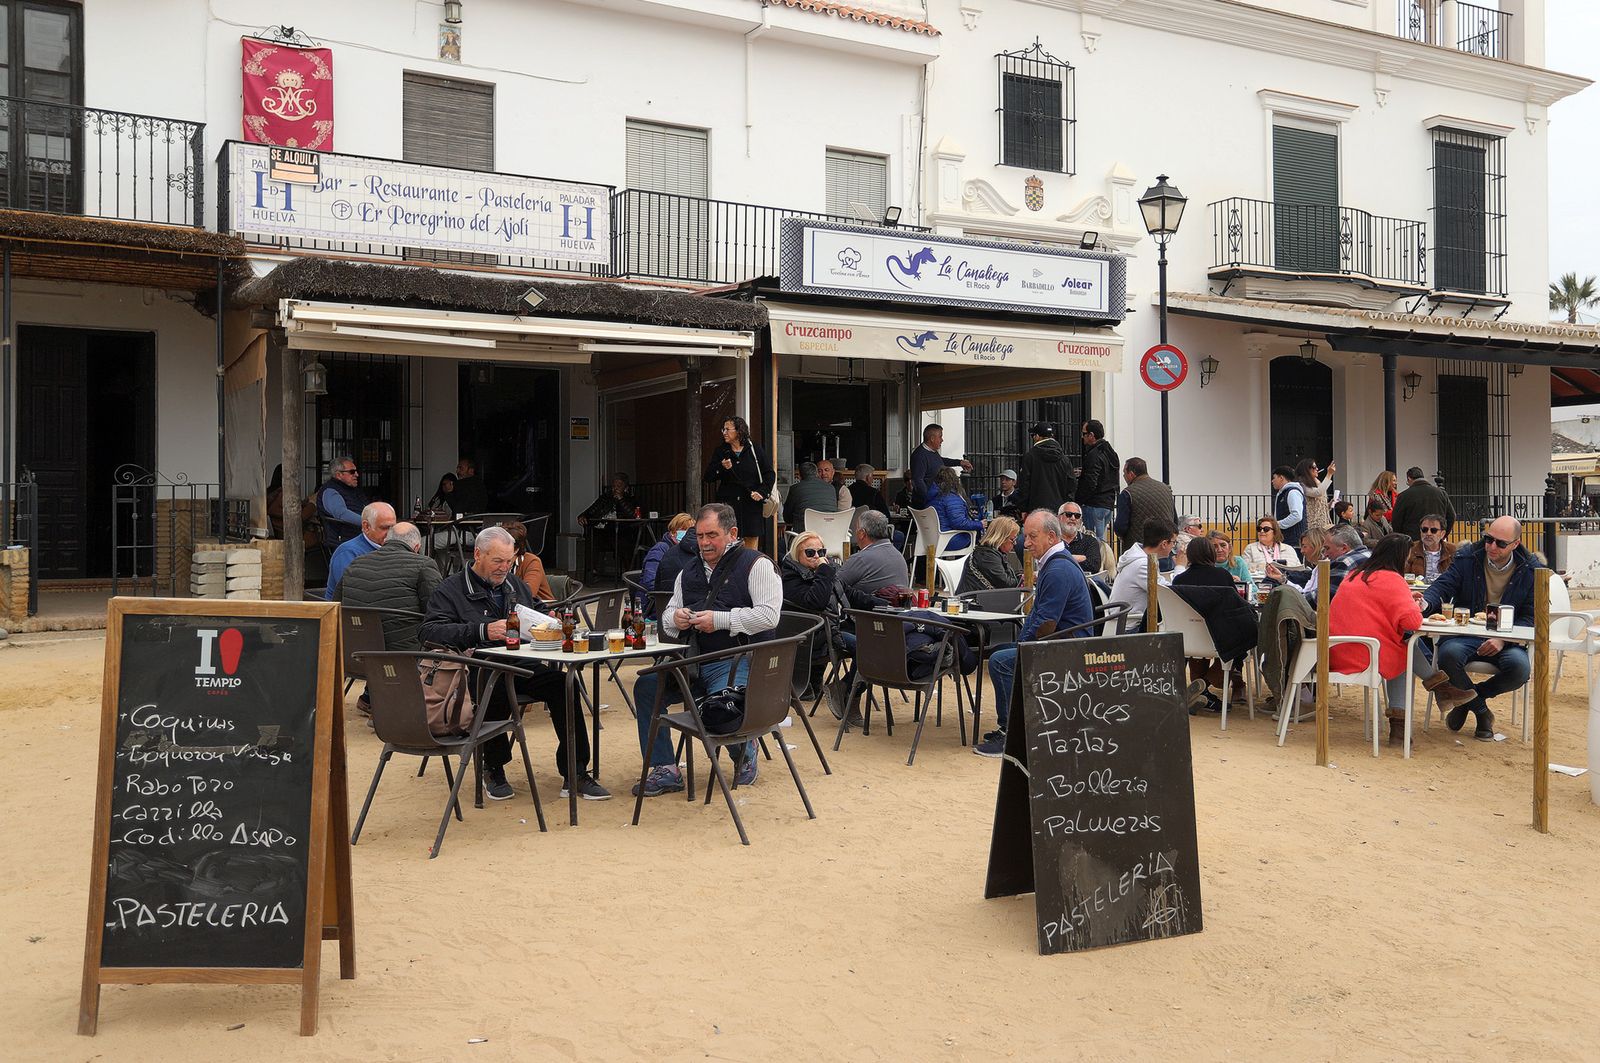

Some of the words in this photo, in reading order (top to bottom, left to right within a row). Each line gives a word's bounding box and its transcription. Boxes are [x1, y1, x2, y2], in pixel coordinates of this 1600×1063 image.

[271, 149, 282, 161] SE
[284, 150, 319, 166] ALQUILA
[364, 174, 459, 203] Restaurante
[479, 187, 552, 213] Pastelería
[560, 193, 596, 206] PALADAR
[252, 210, 297, 223] HUELVA
[358, 202, 382, 223] Er
[387, 205, 465, 235] Peregrino
[470, 213, 490, 233] del
[494, 217, 529, 242] Ajolí
[560, 239, 596, 250] HUELVA
[937, 255, 954, 280] La
[957, 260, 1009, 289] Canaliega
[1021, 280, 1055, 291] BARBADILLO
[1061, 277, 1093, 290] Solear
[785, 321, 853, 341] Cruzcampo
[799, 341, 840, 352] ESPECIAL
[943, 332, 959, 356] La
[961, 334, 1015, 361] Canaliega
[1057, 340, 1111, 358] Cruzcampo
[1068, 357, 1101, 367] ESPECIAL
[195, 629, 219, 675] I
[1084, 651, 1126, 665] Mahou
[1085, 665, 1109, 673] DESDE
[194, 677, 242, 688] TEMPLO
[1039, 667, 1141, 696] BANDEJA
[1035, 693, 1130, 725] Dulces
[127, 773, 182, 795] Rabo
[187, 775, 234, 795] Toro
